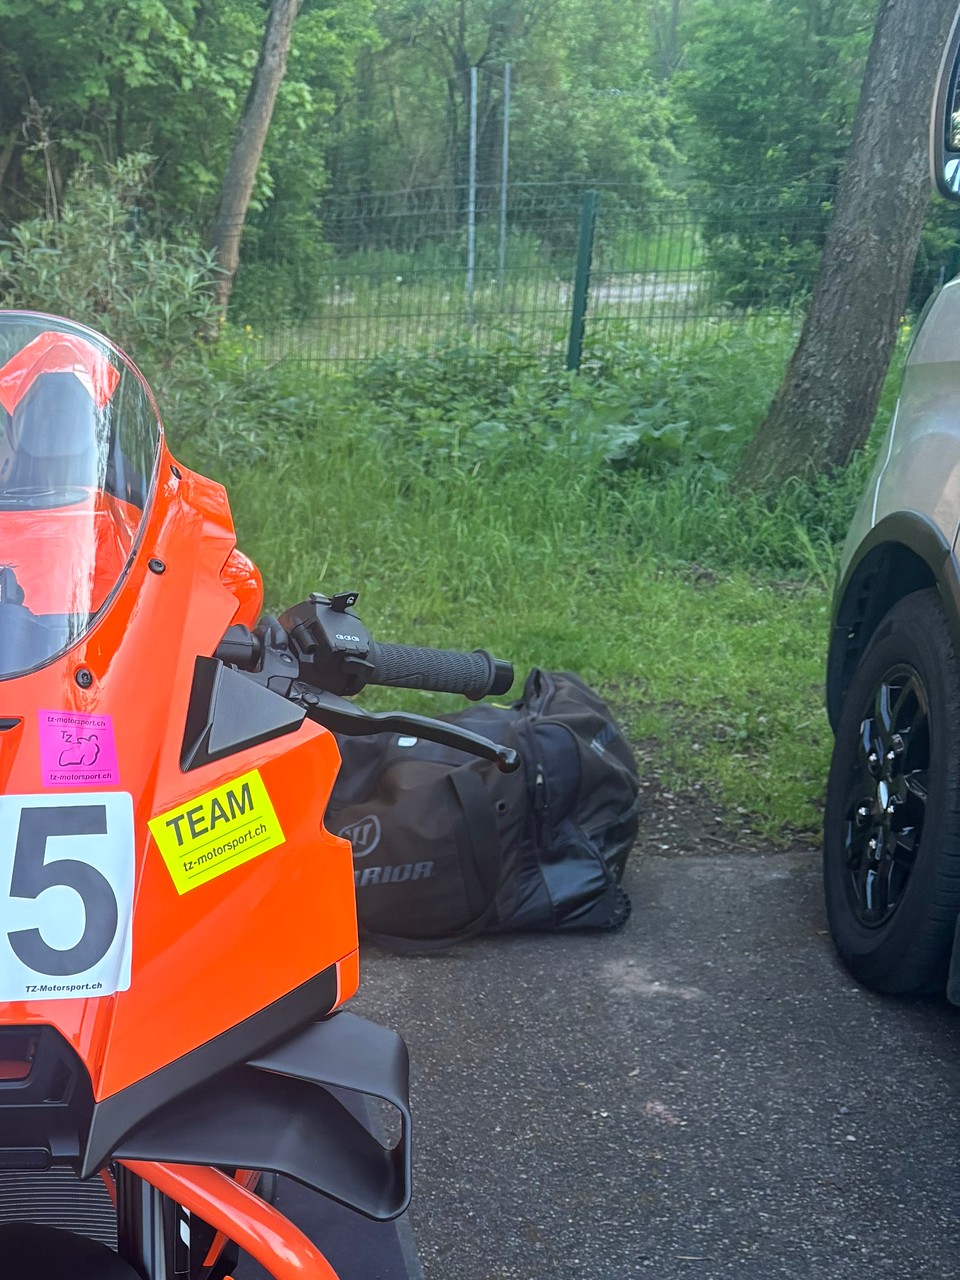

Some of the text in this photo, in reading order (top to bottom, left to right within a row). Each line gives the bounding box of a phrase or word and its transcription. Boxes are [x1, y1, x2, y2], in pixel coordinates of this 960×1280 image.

[47, 716, 106, 727] tz-motorsport.ch
[50, 772, 112, 781] tz-motorsport.ch
[165, 782, 255, 847] TEAM
[183, 823, 267, 872] tz-motorsport.ch
[355, 861, 434, 887] RIOR
[25, 982, 102, 994] TZ-Motorsport.ch
